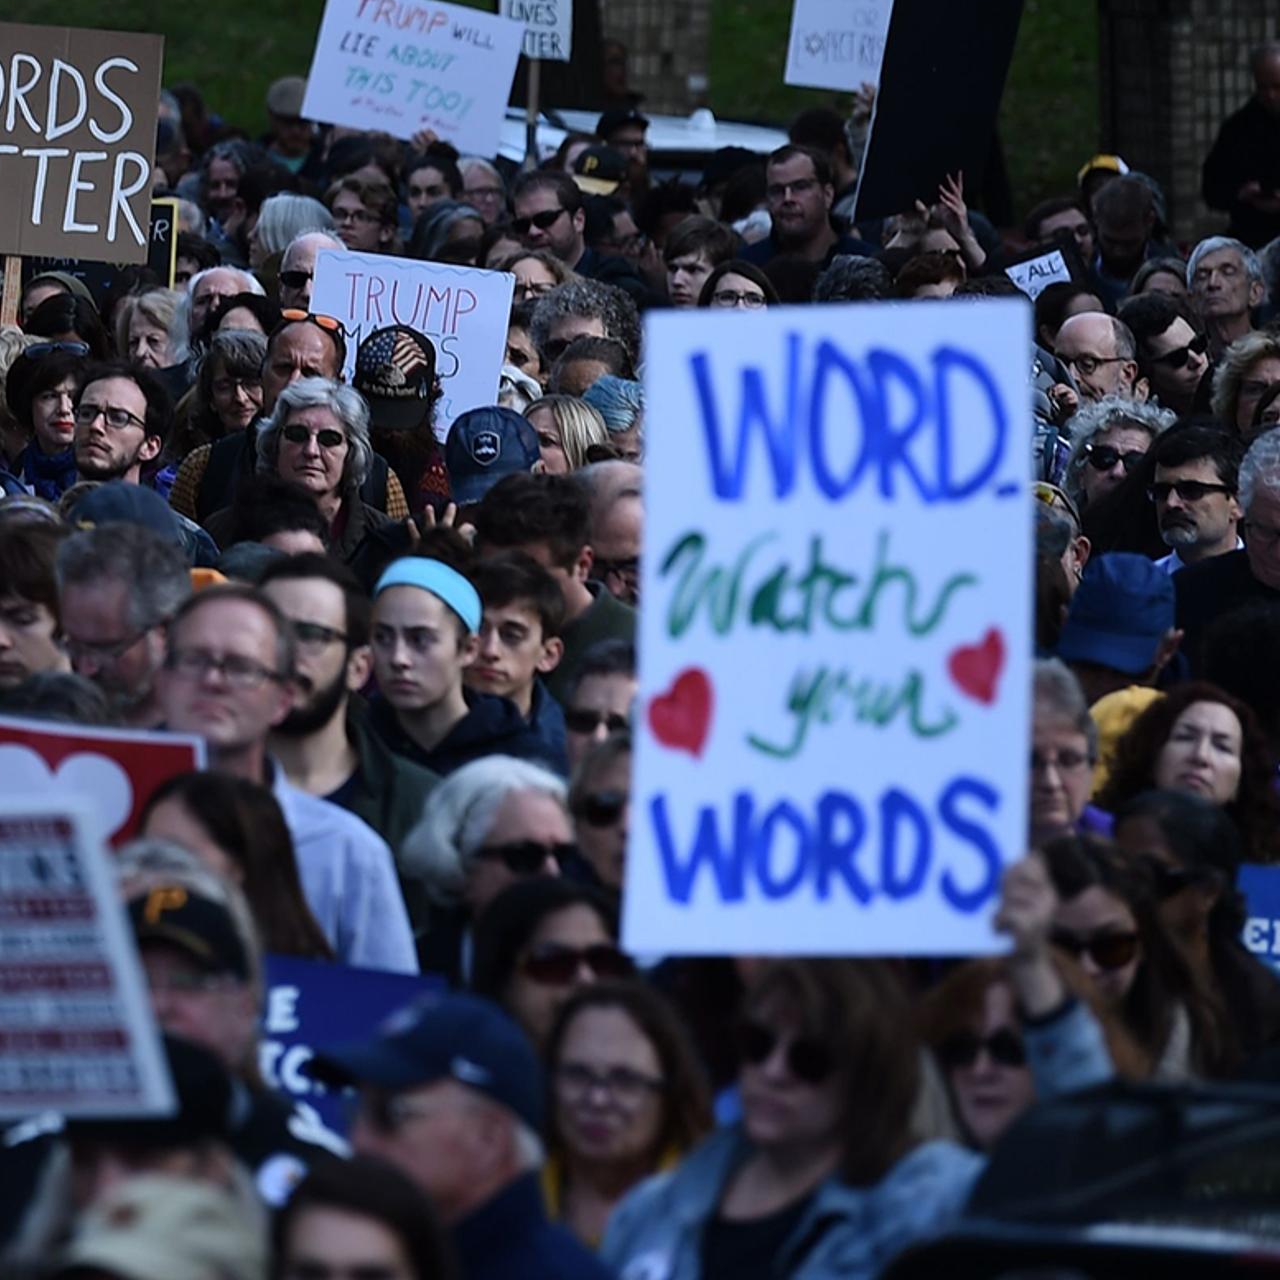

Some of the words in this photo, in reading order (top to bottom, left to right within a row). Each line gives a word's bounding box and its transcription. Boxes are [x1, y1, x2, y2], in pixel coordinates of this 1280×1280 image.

[507, 0, 559, 26] LIVES
[340, 30, 381, 58] LIE
[389, 43, 458, 73] ABOUT
[451, 24, 496, 52] WILL
[344, 64, 399, 96] THIS
[345, 272, 477, 335] TRUMP
[648, 774, 1004, 916] WORDS
